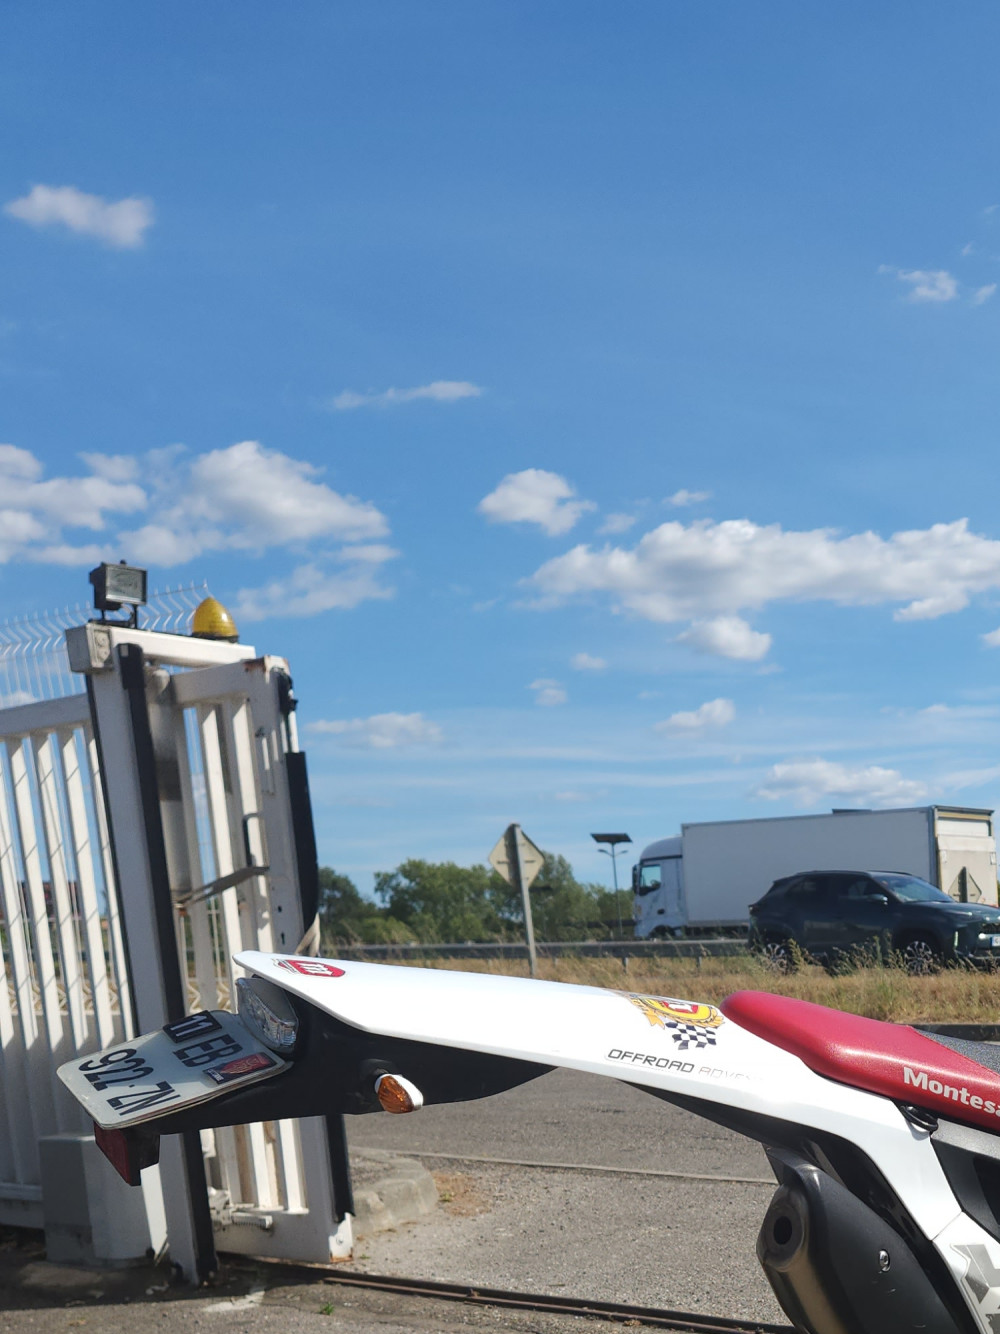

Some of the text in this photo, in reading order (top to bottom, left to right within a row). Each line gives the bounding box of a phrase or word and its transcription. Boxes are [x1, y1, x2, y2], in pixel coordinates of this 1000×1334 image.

[170, 1015, 243, 1068] 11 EB
[607, 1048, 695, 1073] OFFROAD
